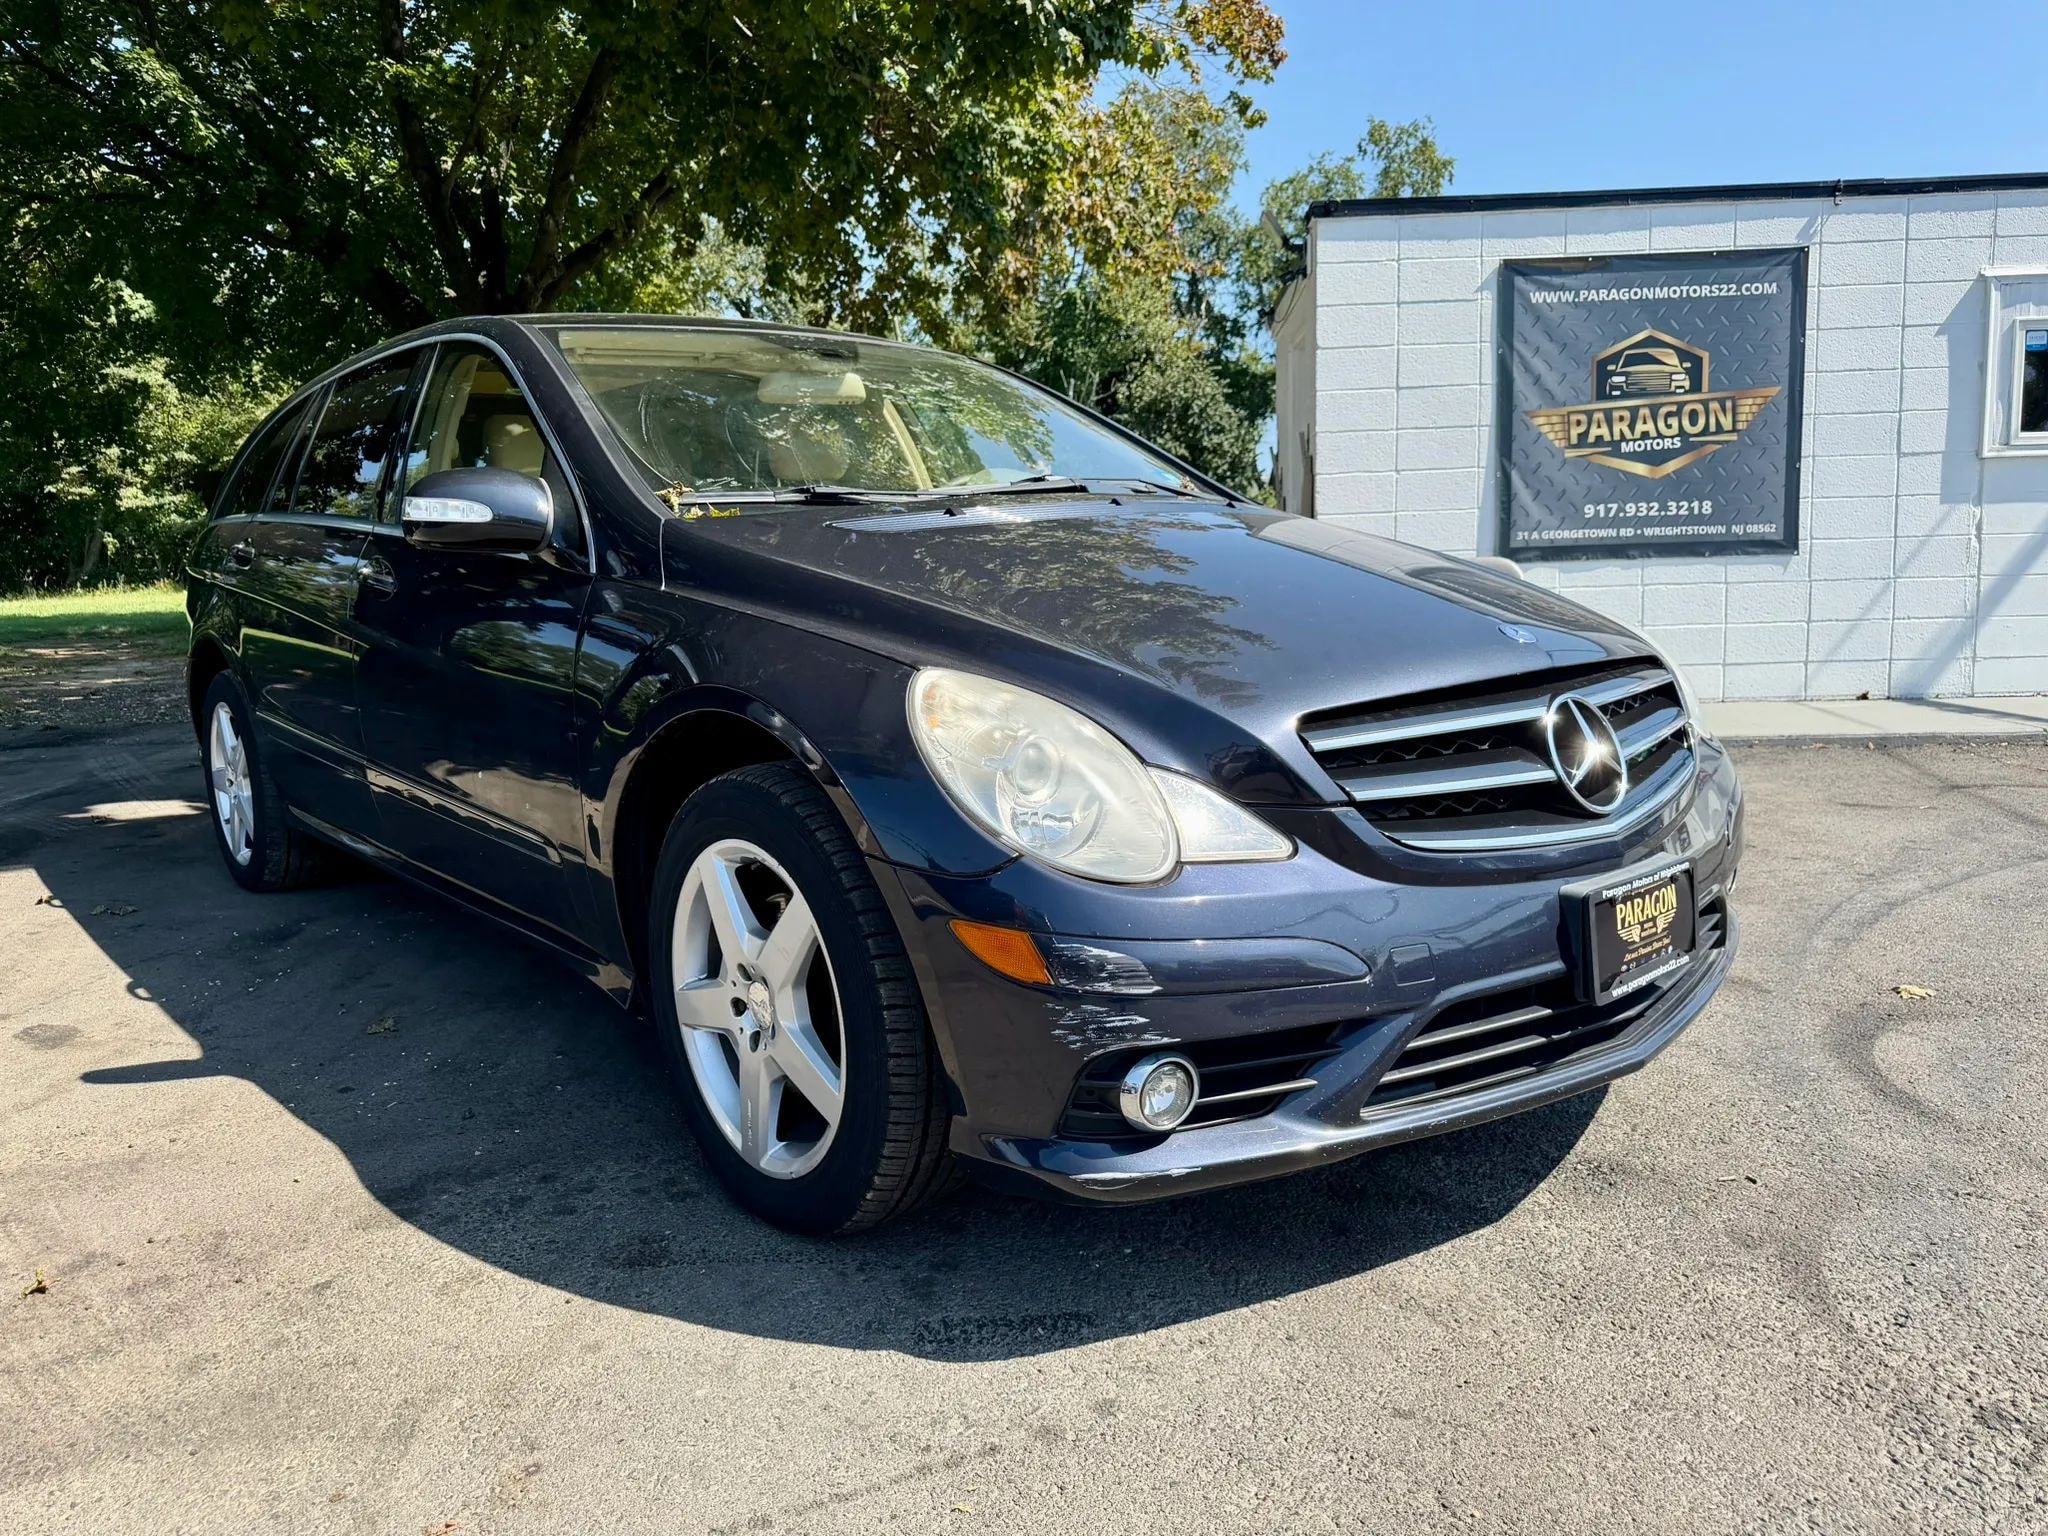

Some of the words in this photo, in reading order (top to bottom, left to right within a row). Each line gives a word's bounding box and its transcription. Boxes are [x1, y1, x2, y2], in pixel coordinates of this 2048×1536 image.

[1530, 282, 1777, 303] WWW.PARAGONMOTORS22.COM
[1568, 399, 1733, 445] PARAGON
[1620, 437, 1682, 454] MOTORS
[1583, 500, 1713, 519] 917.932.3218
[1516, 531, 1529, 540] 31
[1530, 531, 1540, 540] A
[1541, 529, 1617, 539] GEORGETOWN
[1619, 529, 1634, 538] RD
[1643, 525, 1726, 536] WRIGHTSTOWN
[1731, 524, 1744, 535] NJ
[1746, 523, 1777, 534] 08562
[1616, 884, 1677, 930] PARAGON
